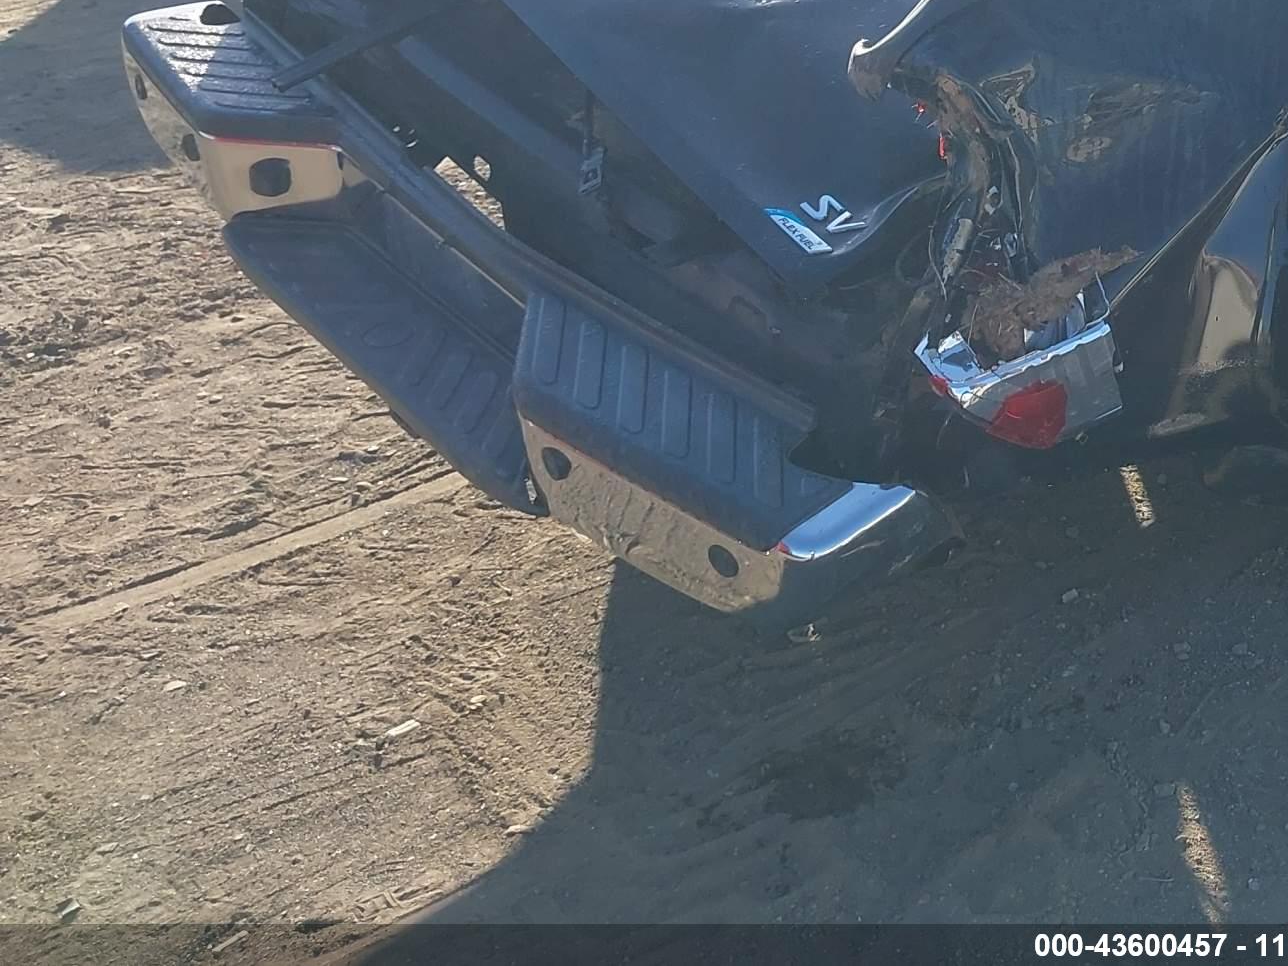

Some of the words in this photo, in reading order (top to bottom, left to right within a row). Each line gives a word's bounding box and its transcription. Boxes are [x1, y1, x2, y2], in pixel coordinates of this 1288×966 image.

[799, 194, 868, 234] SV
[778, 217, 800, 235] FLEX
[796, 232, 816, 251] FUEL
